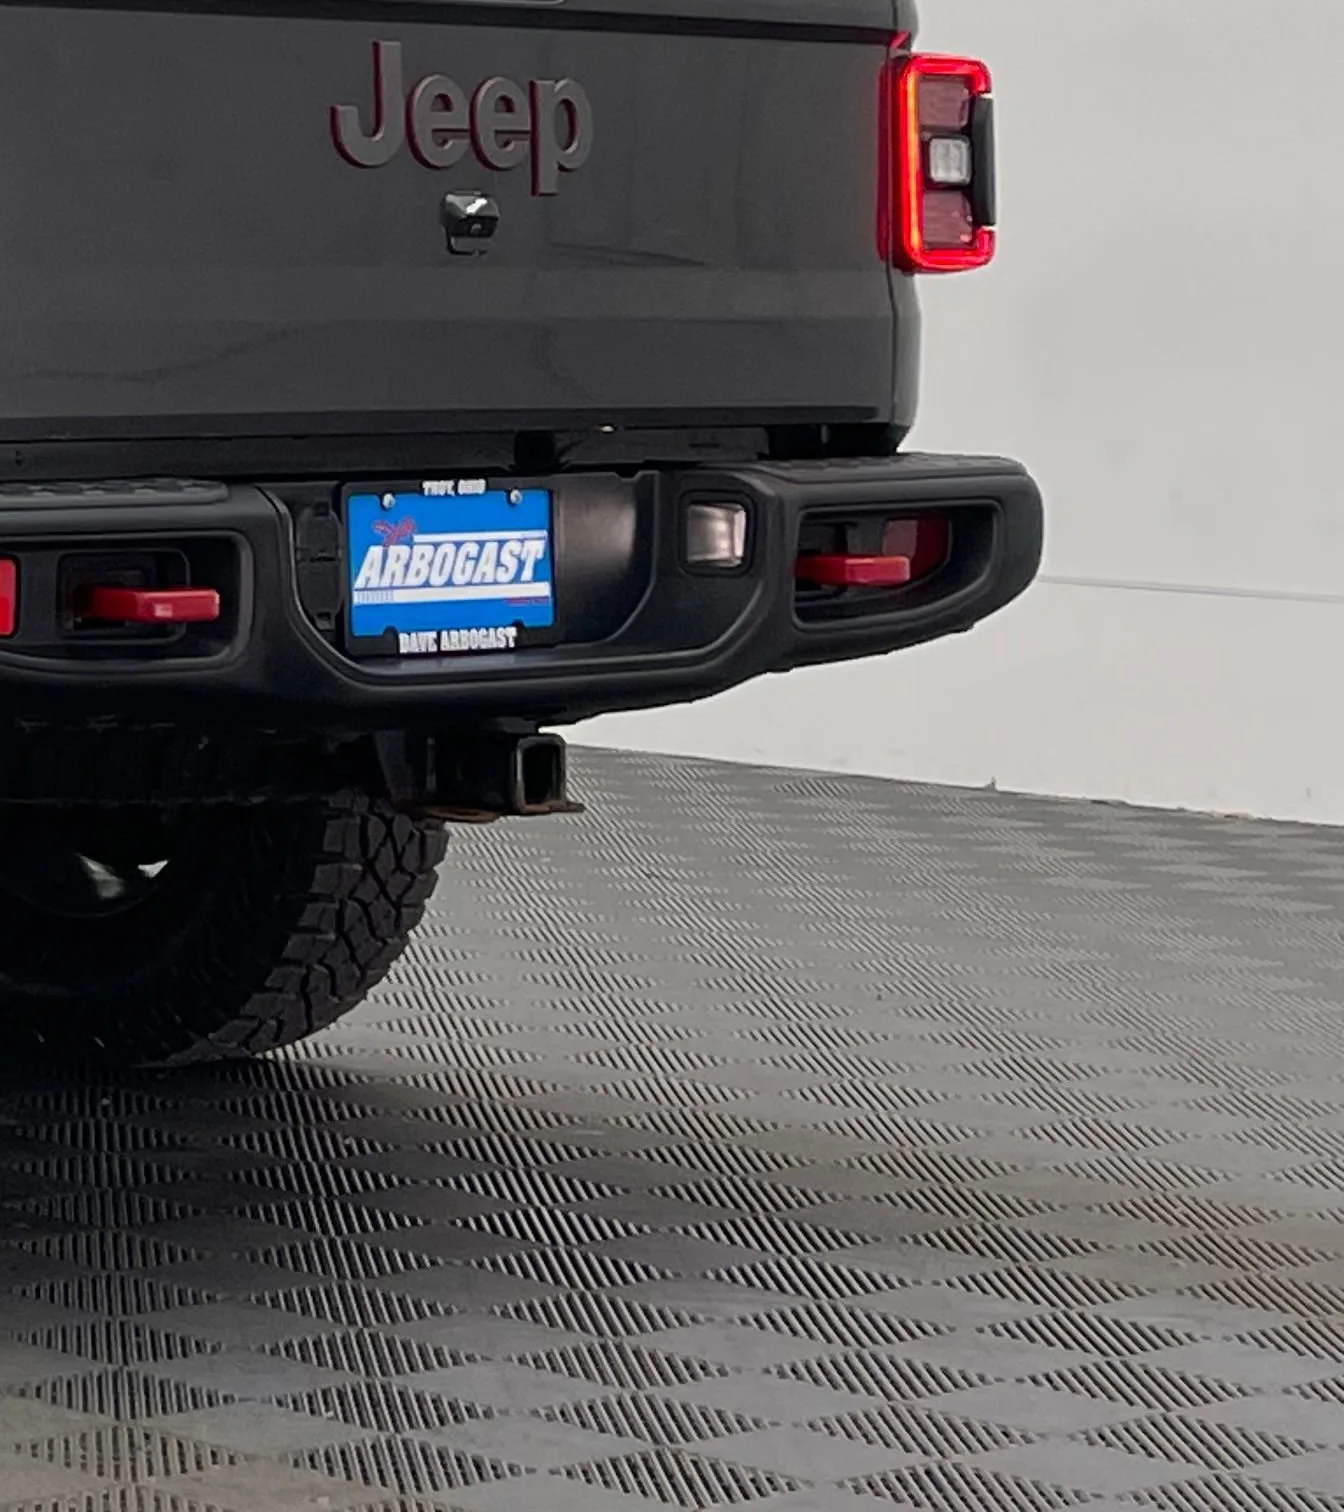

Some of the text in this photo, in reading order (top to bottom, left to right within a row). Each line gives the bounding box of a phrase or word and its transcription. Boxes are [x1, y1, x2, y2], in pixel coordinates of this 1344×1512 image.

[330, 40, 593, 196] Jeep
[353, 539, 546, 589] ARBOGAST
[399, 626, 518, 654] DAVE ARBOGAST
